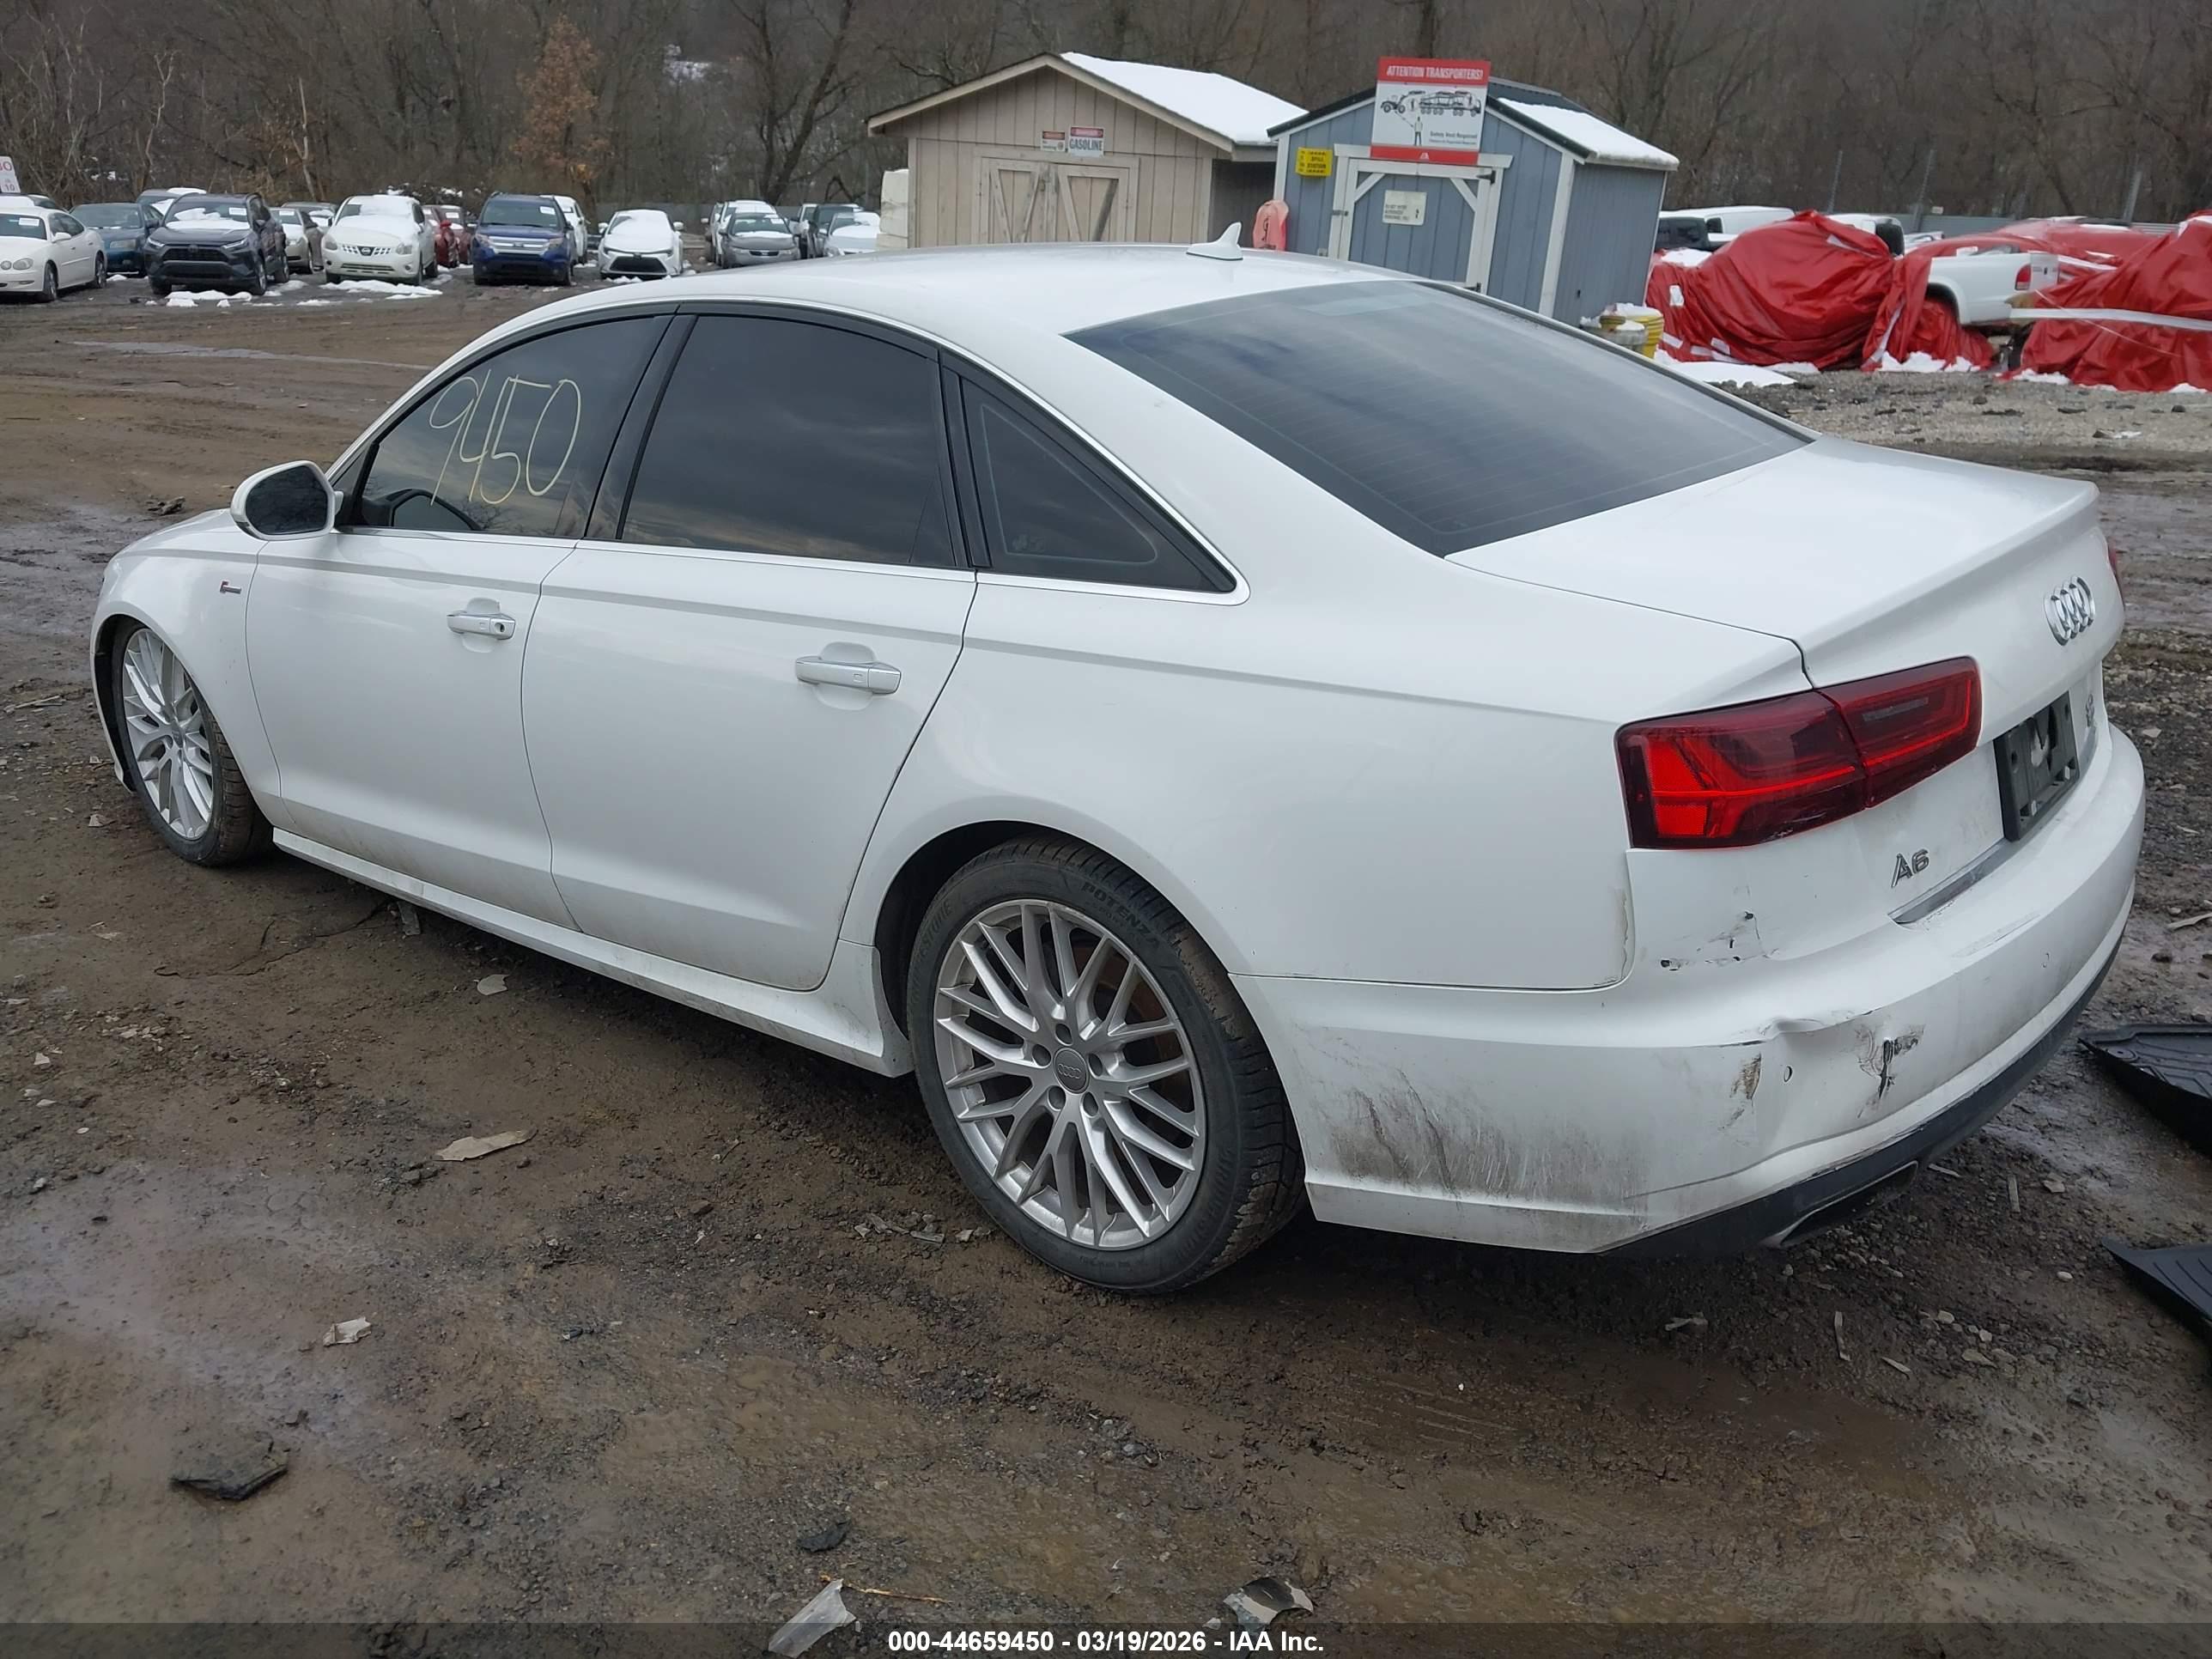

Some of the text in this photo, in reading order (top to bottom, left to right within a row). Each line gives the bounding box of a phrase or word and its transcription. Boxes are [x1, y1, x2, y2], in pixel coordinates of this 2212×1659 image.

[1386, 65, 1483, 80] ATTENTION TRANSPORTERS!
[1070, 138, 1103, 151] GASOLINE
[429, 369, 581, 506] 9450
[1891, 848, 1929, 888] A6
[1081, 881, 1160, 950] POTENZA
